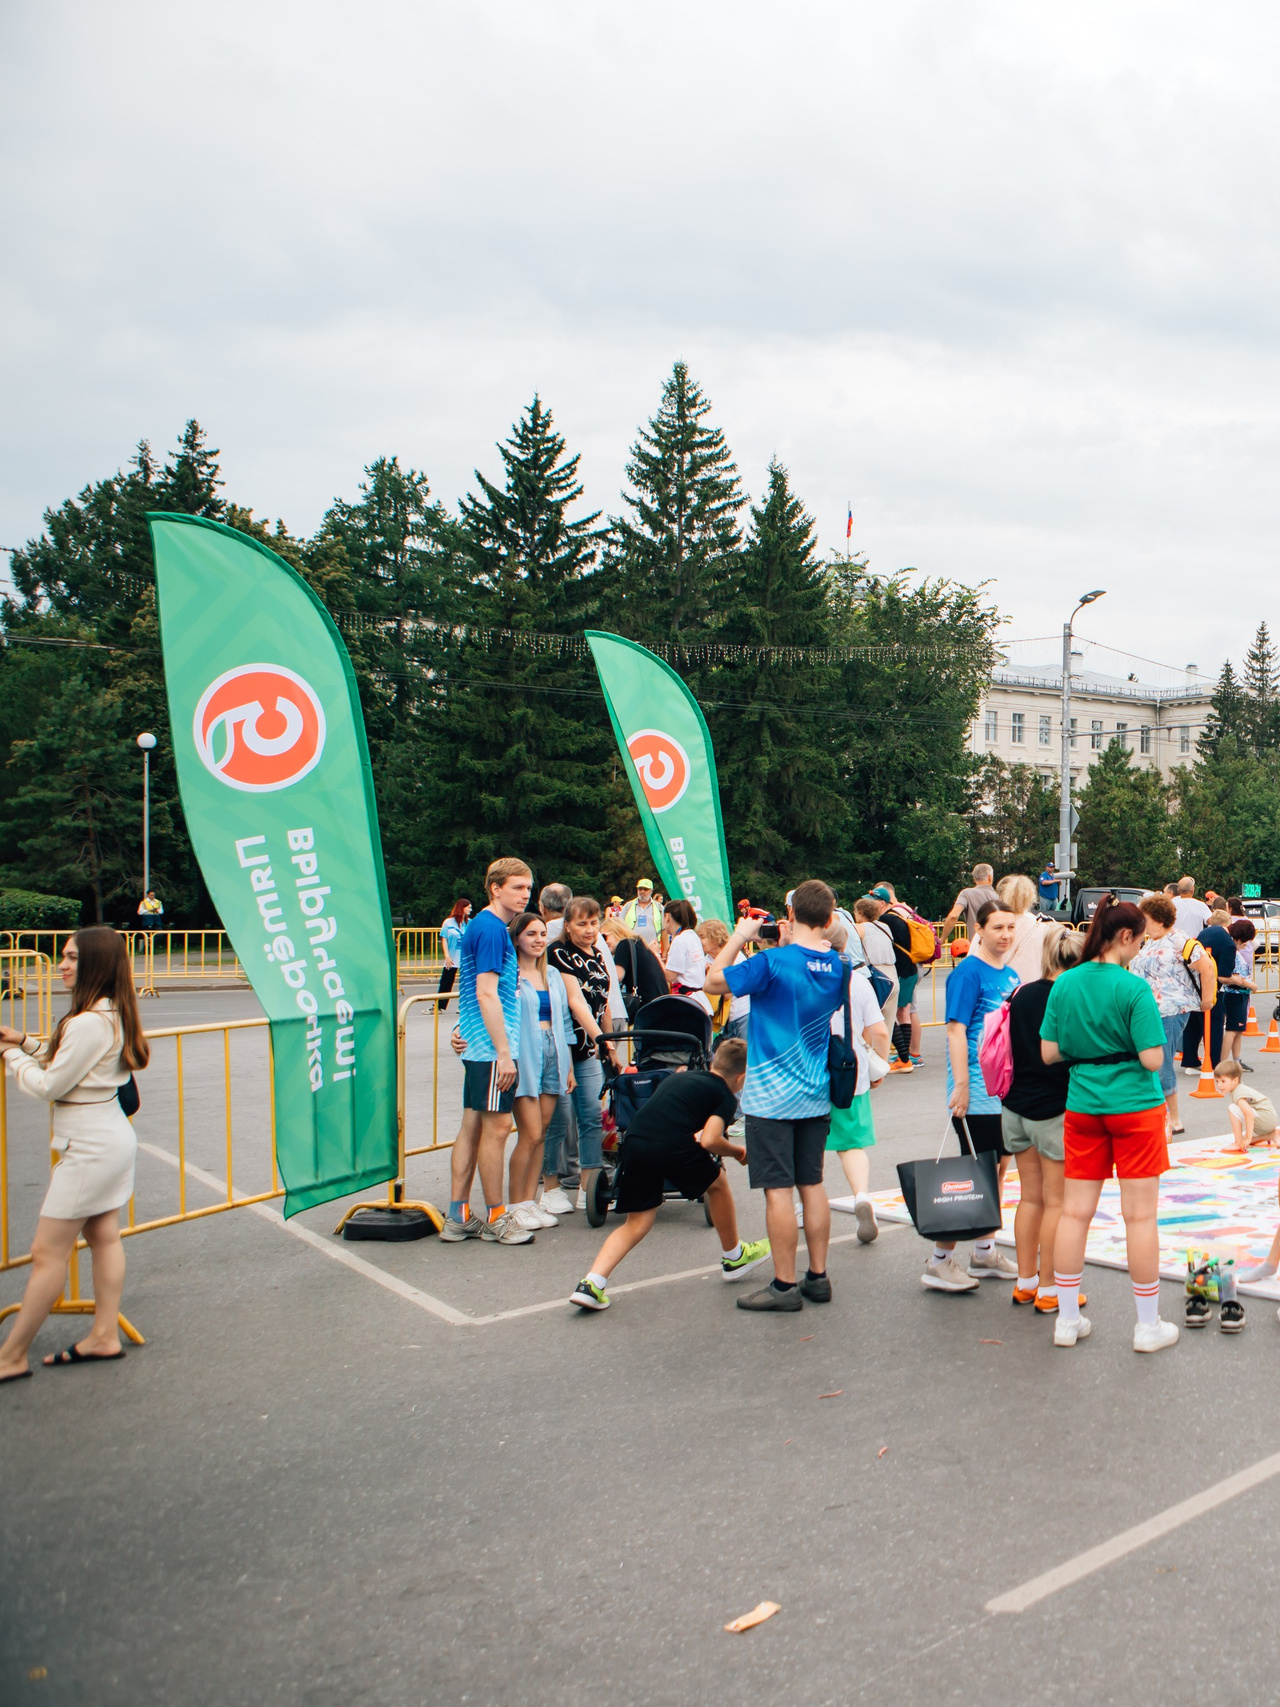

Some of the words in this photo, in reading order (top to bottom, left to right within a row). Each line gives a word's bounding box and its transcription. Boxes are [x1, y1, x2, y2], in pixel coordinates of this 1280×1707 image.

[806, 959, 833, 973] SIM
[943, 1183, 971, 1191] Ehrmann
[955, 1193, 984, 1202] PROTEIN
